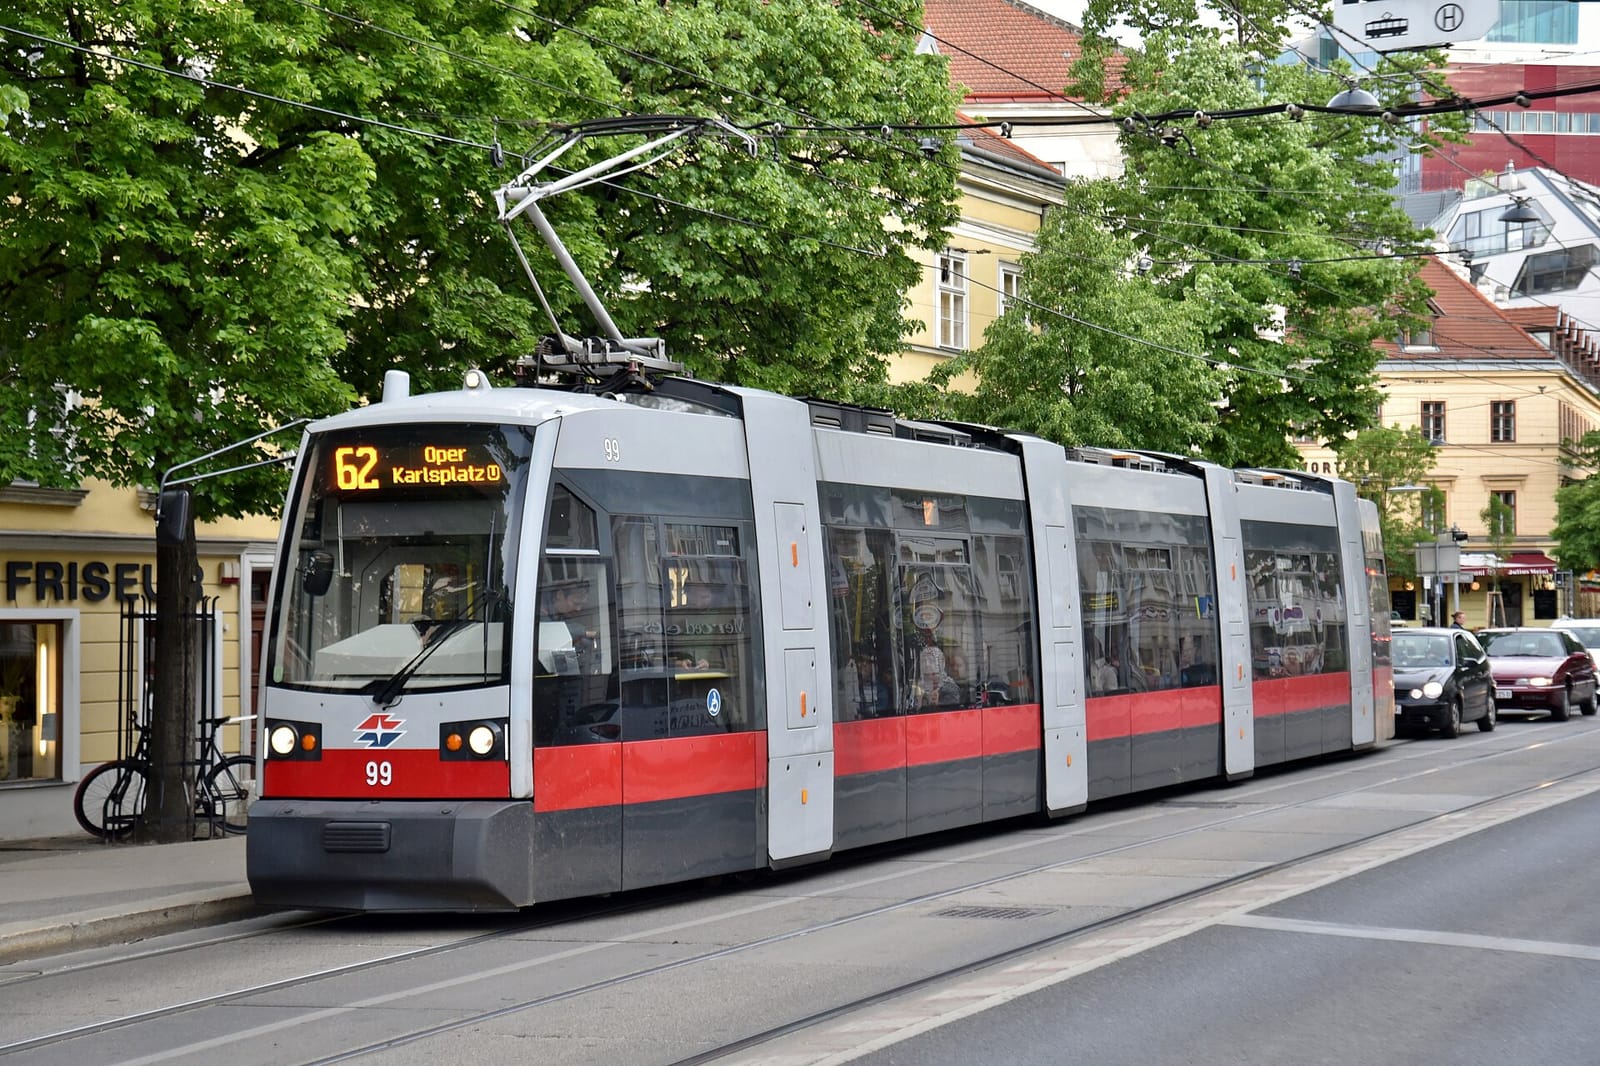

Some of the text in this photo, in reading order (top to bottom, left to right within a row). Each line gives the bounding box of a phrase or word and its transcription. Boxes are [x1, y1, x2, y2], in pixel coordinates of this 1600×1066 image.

[424, 446, 466, 465] Oper
[604, 438, 620, 461] 99
[334, 446, 380, 490] 62
[392, 465, 485, 485] Karlsplatz
[6, 561, 204, 602] FRISEU
[366, 761, 392, 786] 99
